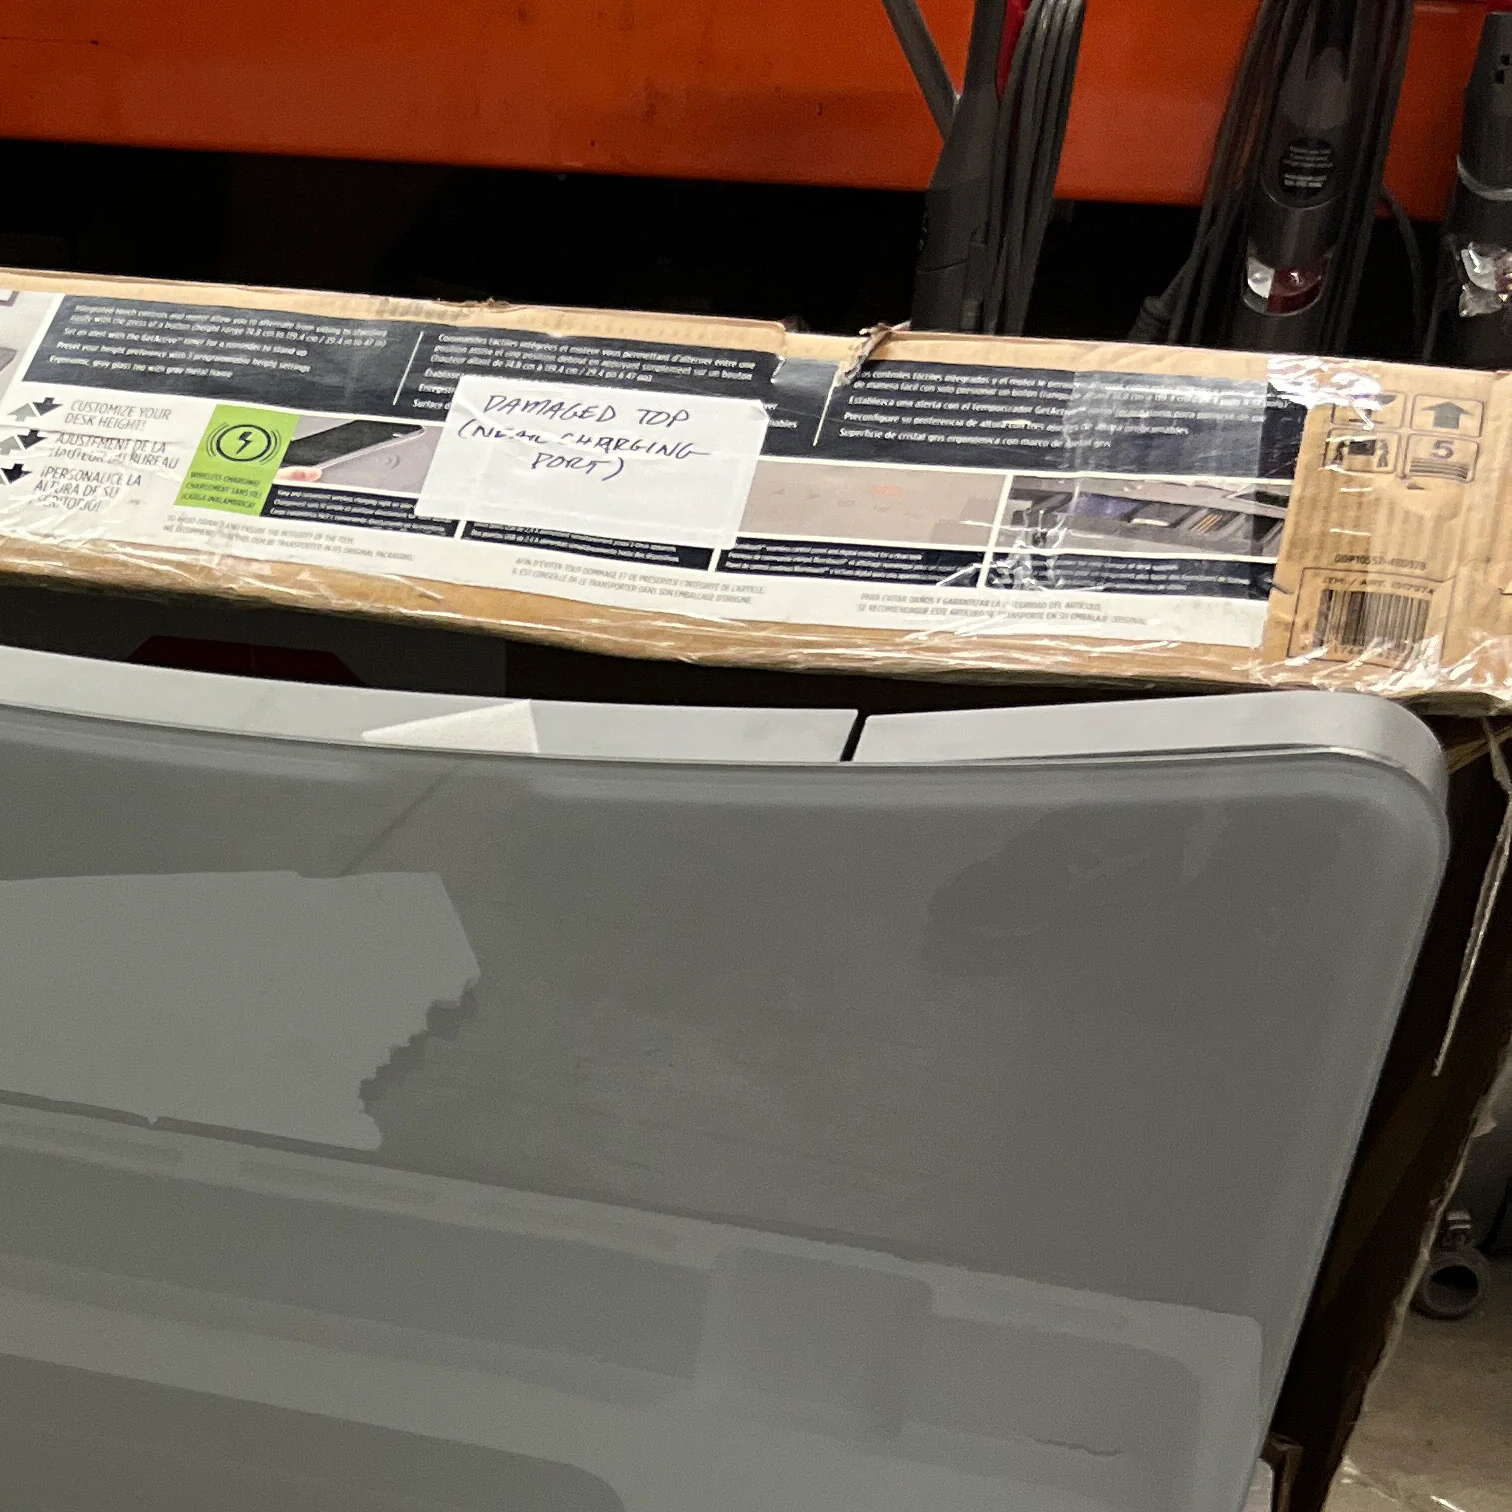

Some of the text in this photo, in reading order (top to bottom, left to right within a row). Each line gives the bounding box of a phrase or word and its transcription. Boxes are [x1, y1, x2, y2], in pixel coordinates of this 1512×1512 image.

[64, 413, 97, 426] DESK
[70, 400, 173, 420] CUSTOMIZE YOUR
[482, 395, 690, 428] DAMAGED TOP
[55, 432, 167, 454] AJUSTEMENT DE LA
[1430, 439, 1455, 460] 5
[531, 452, 625, 482] PORT)
[126, 475, 142, 486] LA
[82, 485, 99, 497] DE
[104, 487, 121, 498] SU
